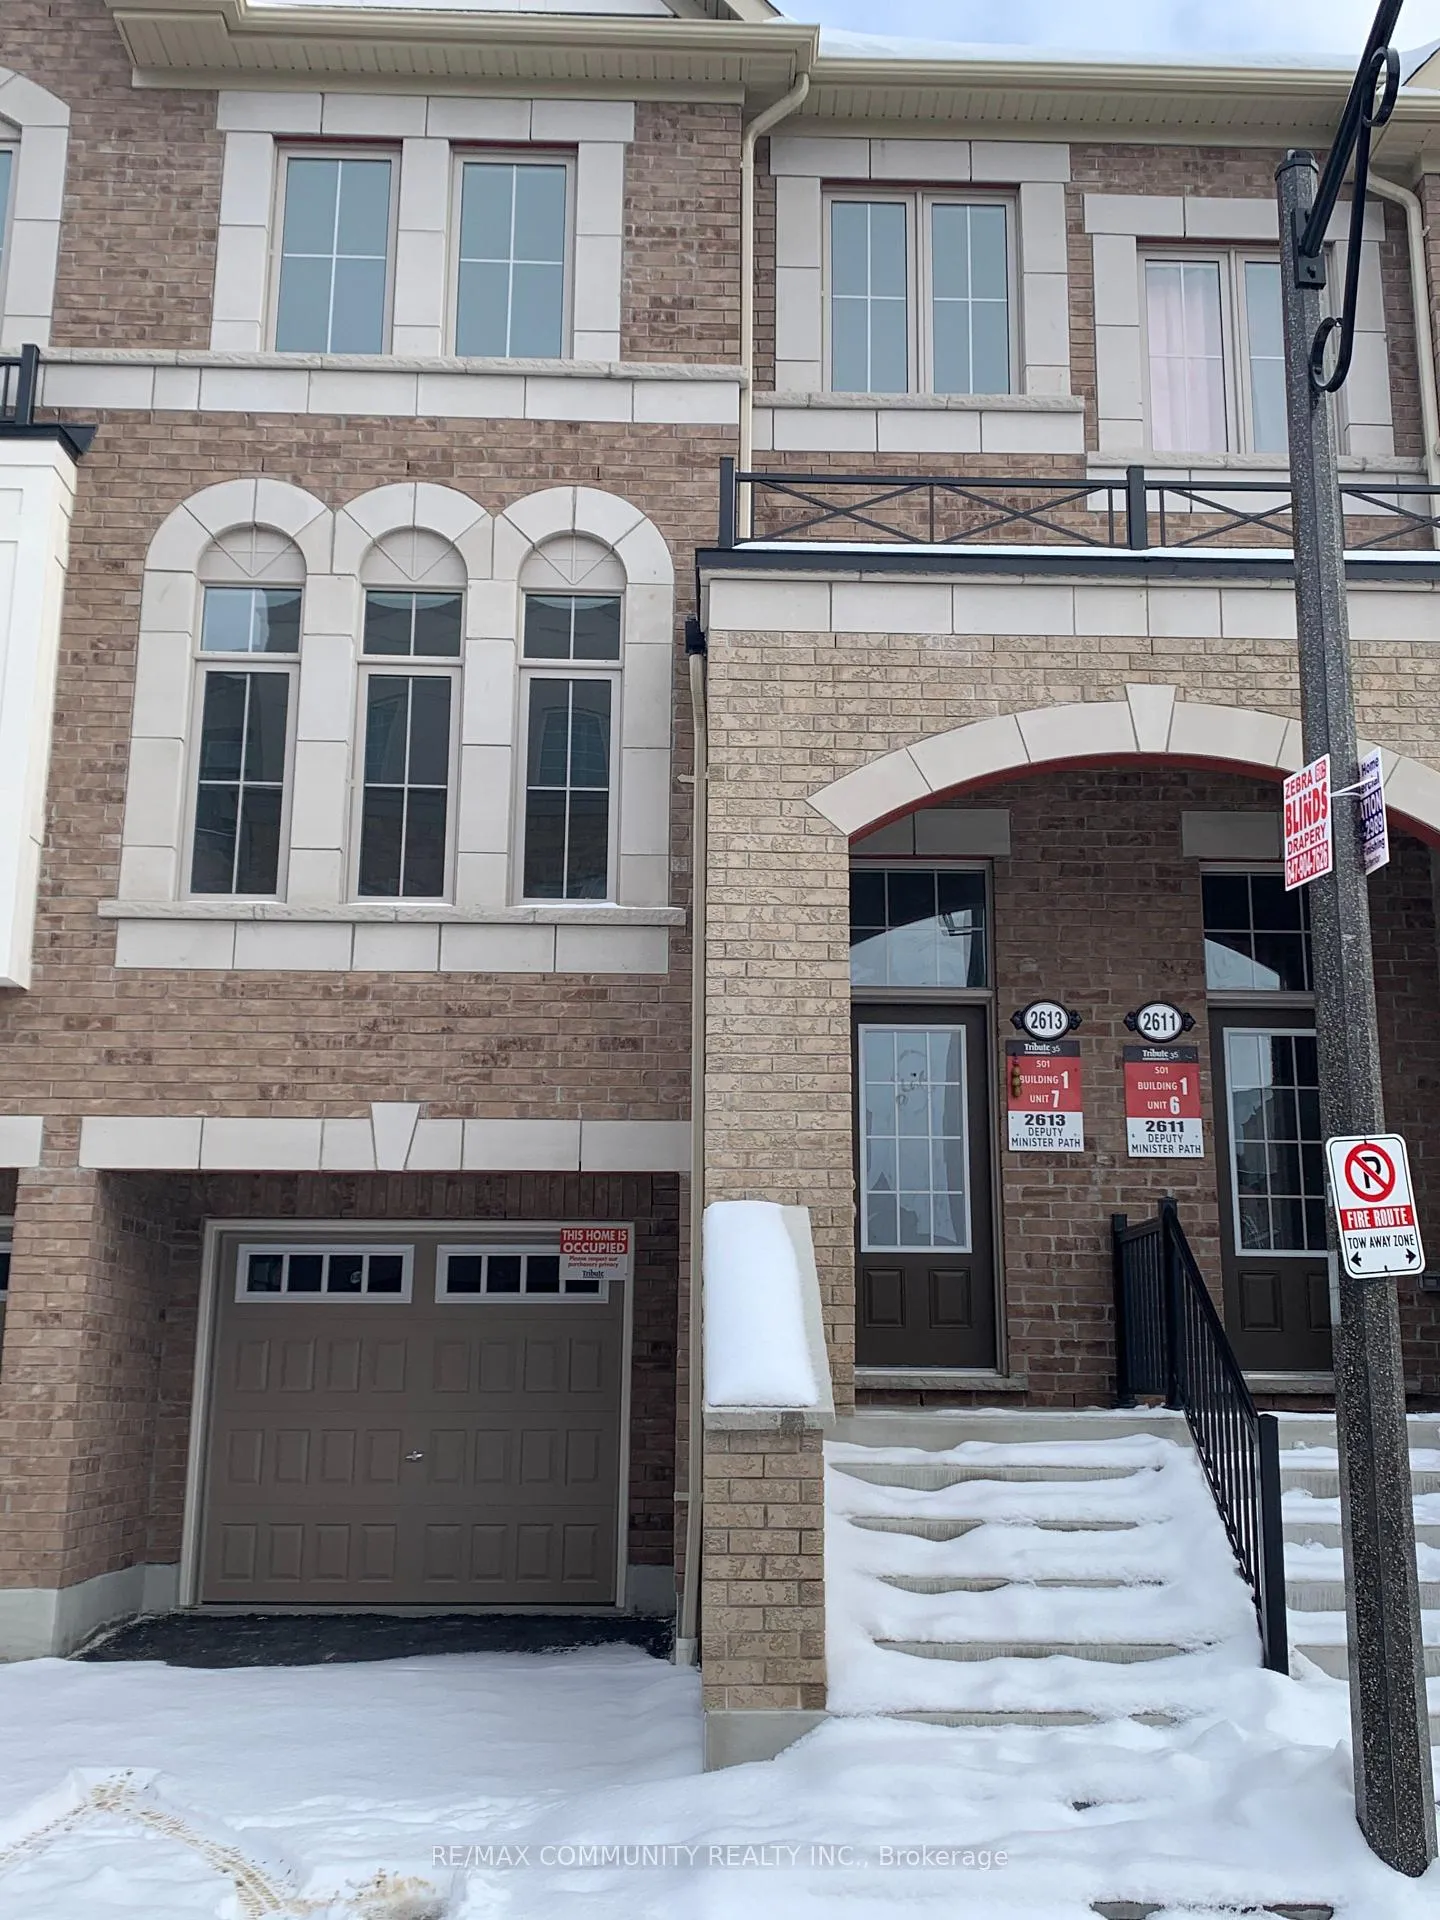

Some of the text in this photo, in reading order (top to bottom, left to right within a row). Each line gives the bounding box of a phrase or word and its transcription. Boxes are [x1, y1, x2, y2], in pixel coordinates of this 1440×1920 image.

[1285, 769, 1313, 800] ZEBRA
[1285, 781, 1328, 838] BLINDS
[1287, 822, 1326, 856] DRAPERY
[1031, 1010, 1063, 1030] 2613
[1143, 1012, 1176, 1031] 2611
[1024, 1042, 1061, 1053] Tribute 35
[1142, 1048, 1179, 1059] Tribute 35
[1020, 1070, 1069, 1089] BUILDING 1
[1137, 1077, 1188, 1095] BUILDING 1
[1029, 1089, 1060, 1108] UNIT 7
[1147, 1095, 1180, 1115] UNIT 6
[1024, 1113, 1066, 1126] 2613
[1145, 1120, 1184, 1133] 2611
[1028, 1127, 1063, 1137] DEPUTY
[1148, 1133, 1183, 1143] DEPUTY
[1011, 1137, 1081, 1148] MINISTER PATH
[1131, 1144, 1201, 1154] MINISTER PATH
[1346, 1207, 1409, 1229] FIRE ROUTE
[562, 1230, 627, 1241] THIS HOME IS
[1348, 1234, 1415, 1250] TOW AWAY ZONE
[563, 1242, 625, 1253] OCCUPIED
